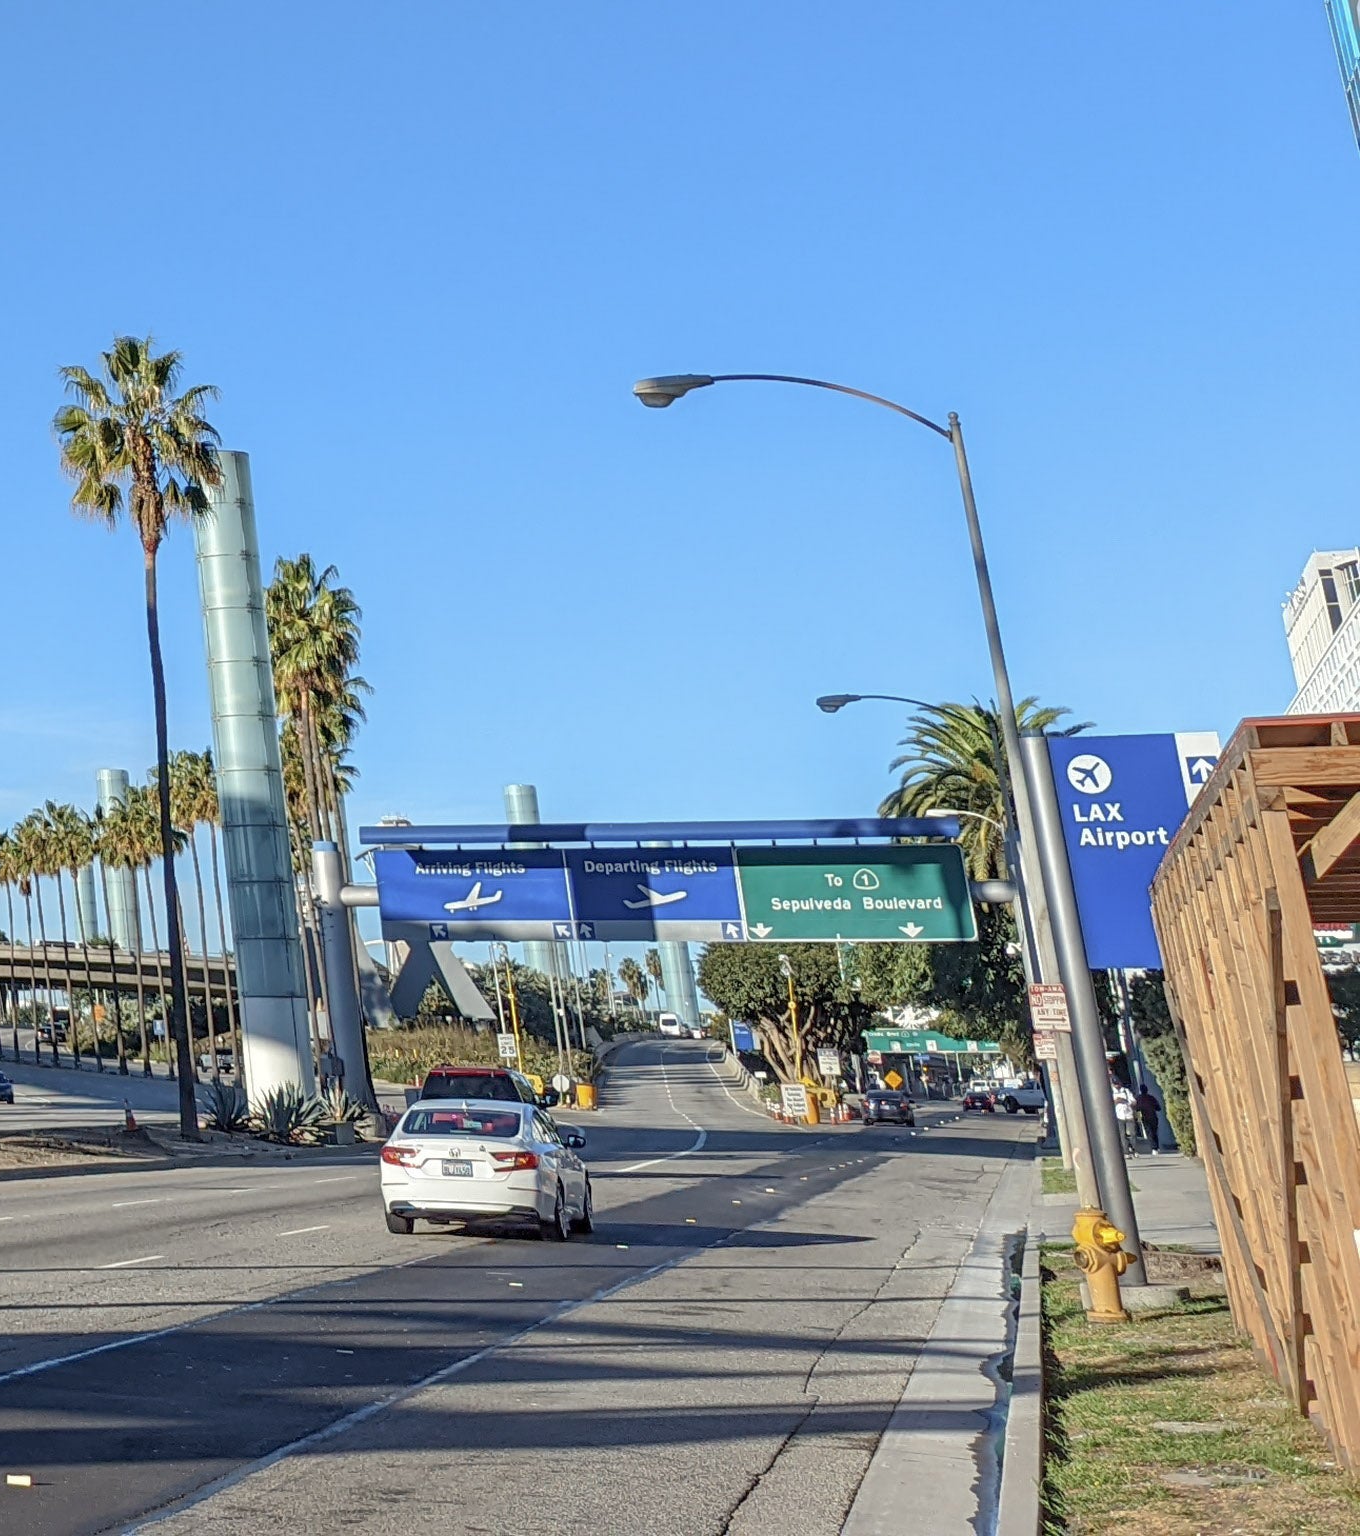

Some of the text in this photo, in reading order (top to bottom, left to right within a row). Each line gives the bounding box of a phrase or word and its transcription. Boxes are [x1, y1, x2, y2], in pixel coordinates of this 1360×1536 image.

[1072, 802, 1124, 822] LAX
[1080, 826, 1169, 850] Airport
[414, 861, 526, 876] Arriving Flights
[583, 859, 718, 876] Departing Flights
[824, 873, 843, 887] To
[771, 896, 943, 913] Sepulveda Boulevard
[500, 1045, 515, 1056] 25
